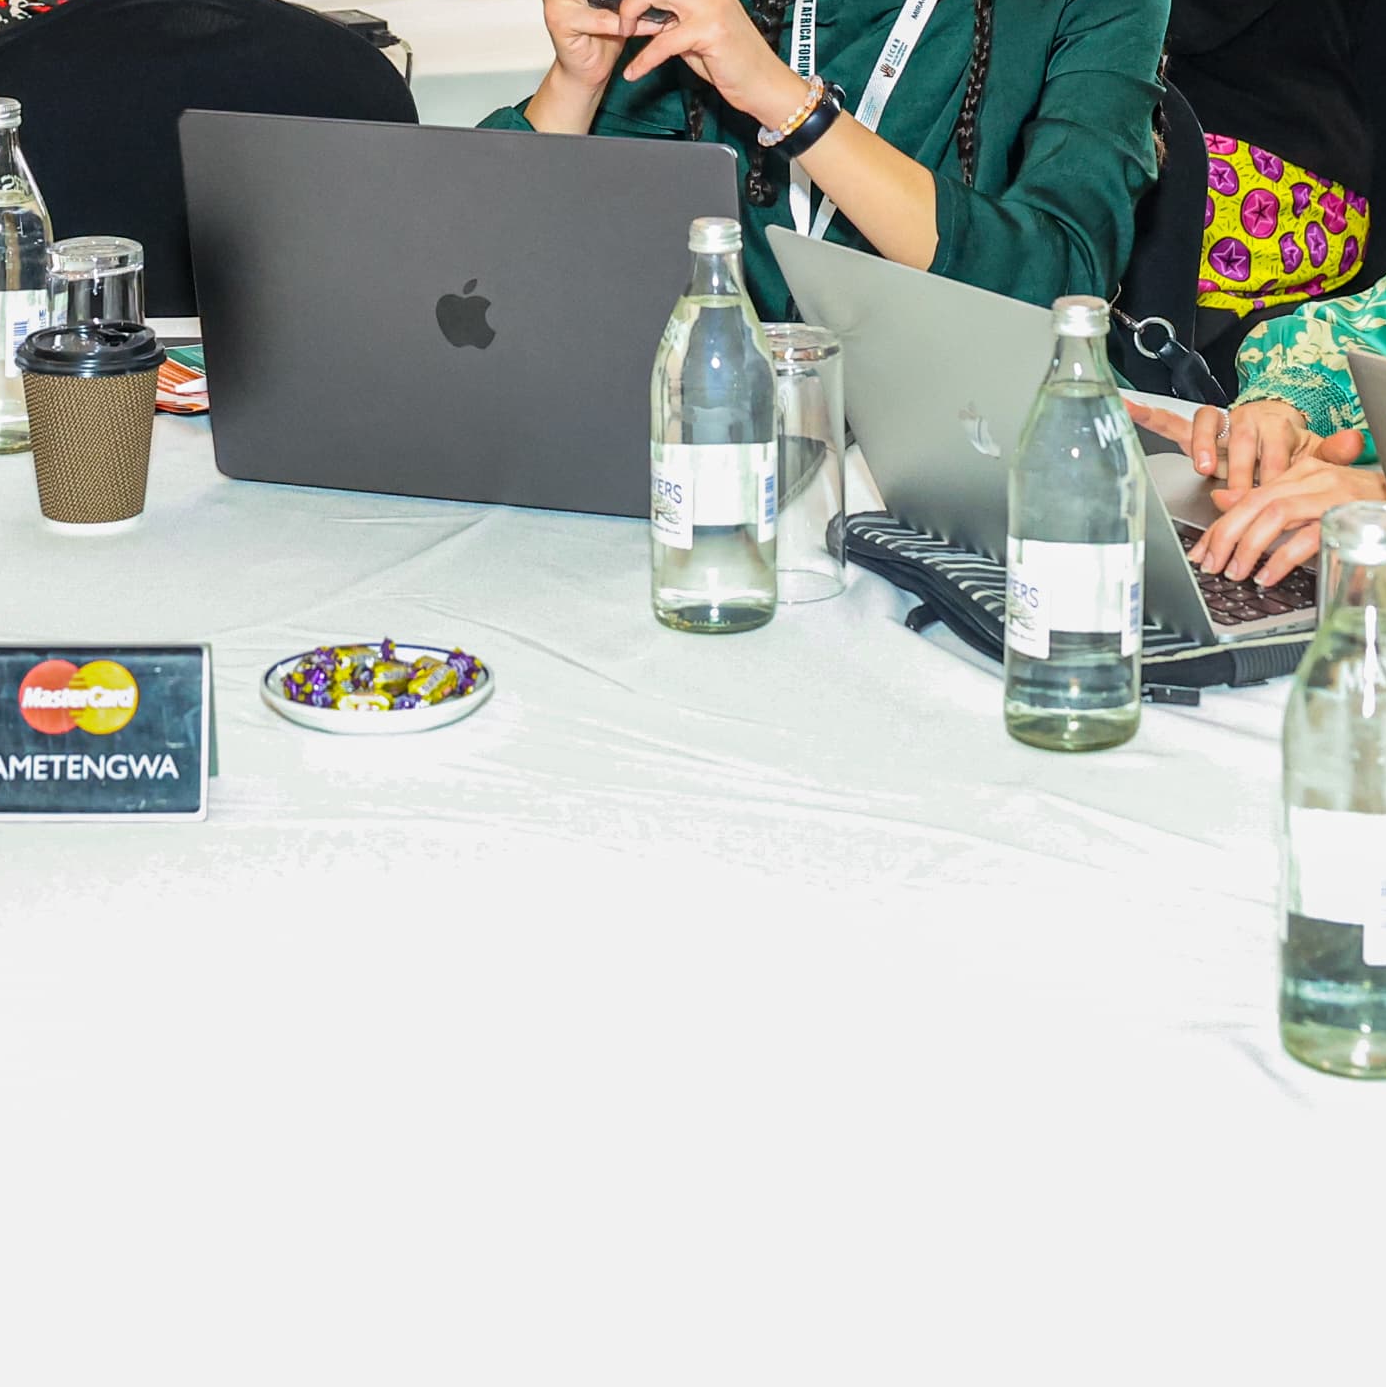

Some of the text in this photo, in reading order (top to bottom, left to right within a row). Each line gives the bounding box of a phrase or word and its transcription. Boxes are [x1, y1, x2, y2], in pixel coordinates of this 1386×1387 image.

[799, 6, 812, 41] AFRICA
[797, 43, 811, 77] FORUM
[21, 684, 135, 709] MasterCard
